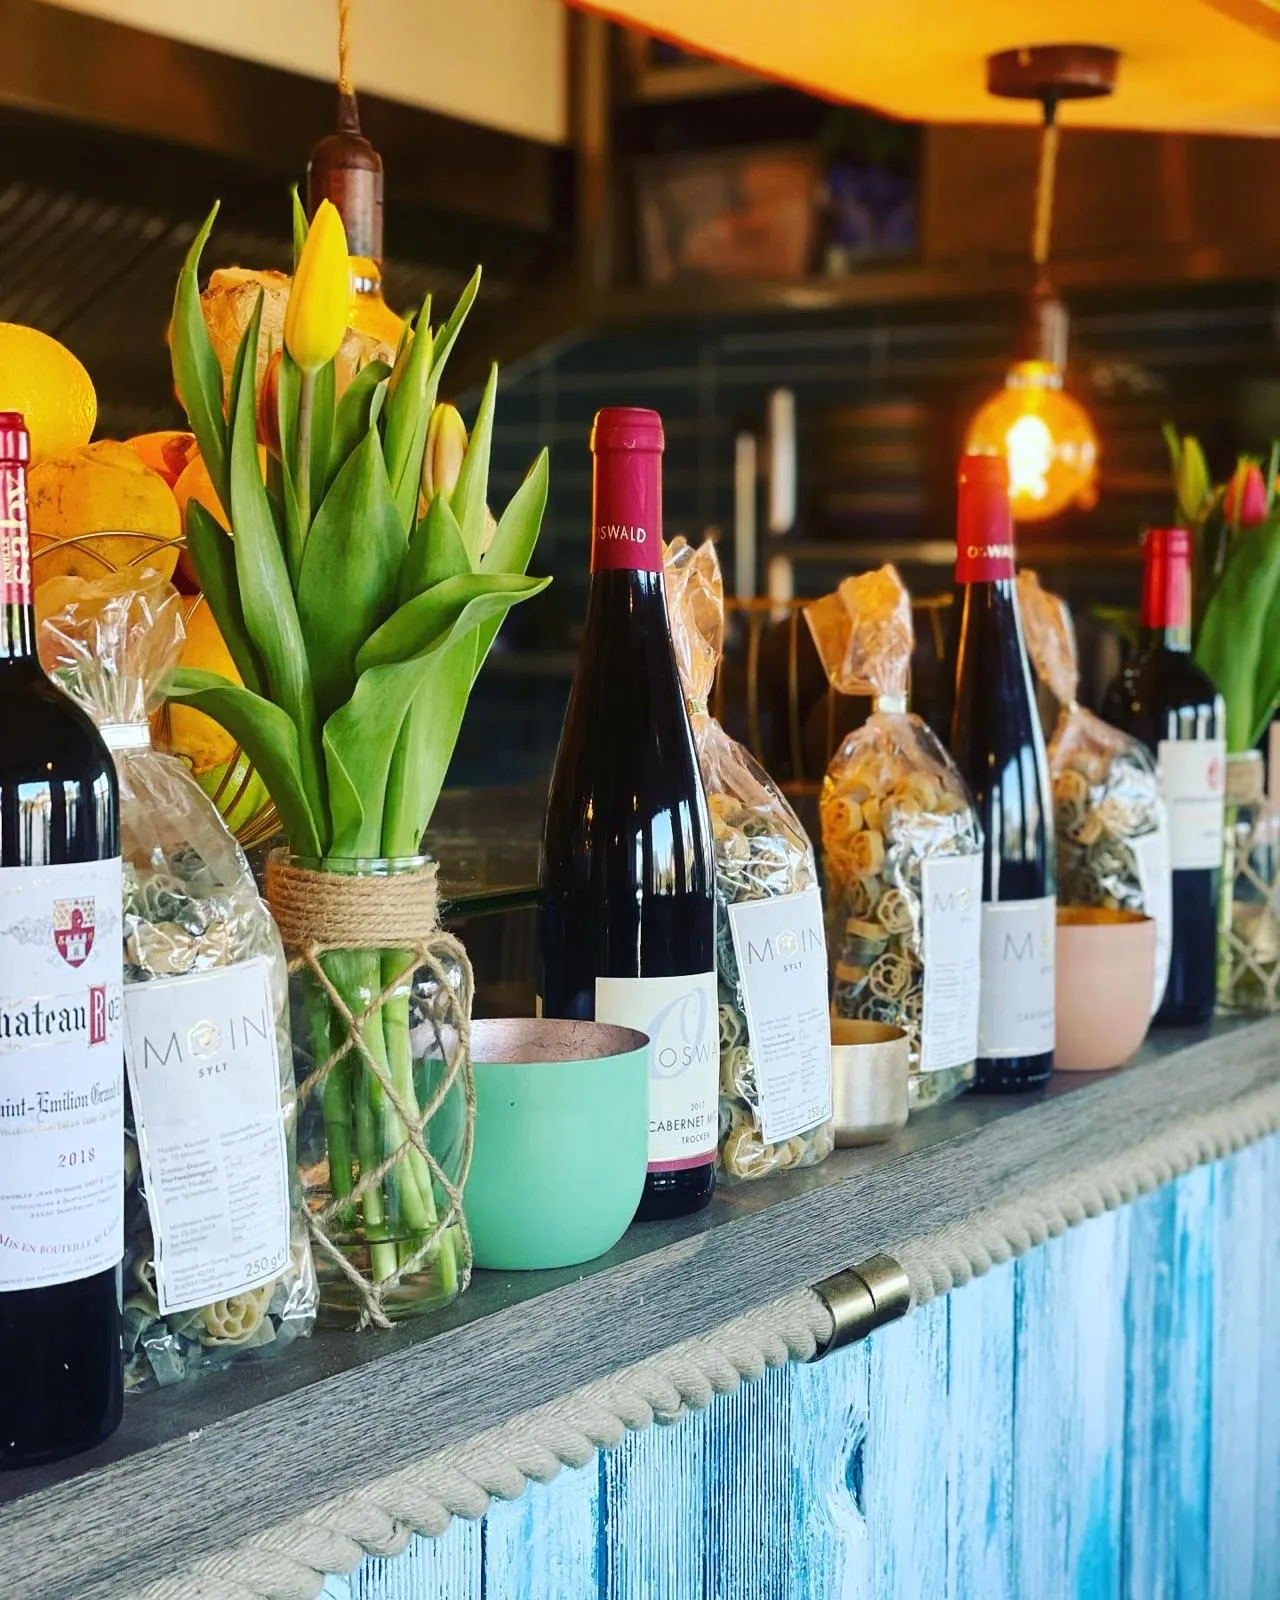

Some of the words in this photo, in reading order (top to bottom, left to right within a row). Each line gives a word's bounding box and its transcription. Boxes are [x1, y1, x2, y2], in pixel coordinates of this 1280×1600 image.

[784, 961, 803, 972] SYLT
[198, 1062, 228, 1078] SYLT
[690, 1101, 704, 1111] 2017
[682, 1132, 710, 1144] TROCKEN
[58, 1148, 95, 1168] 2018
[245, 1253, 268, 1278] 250
